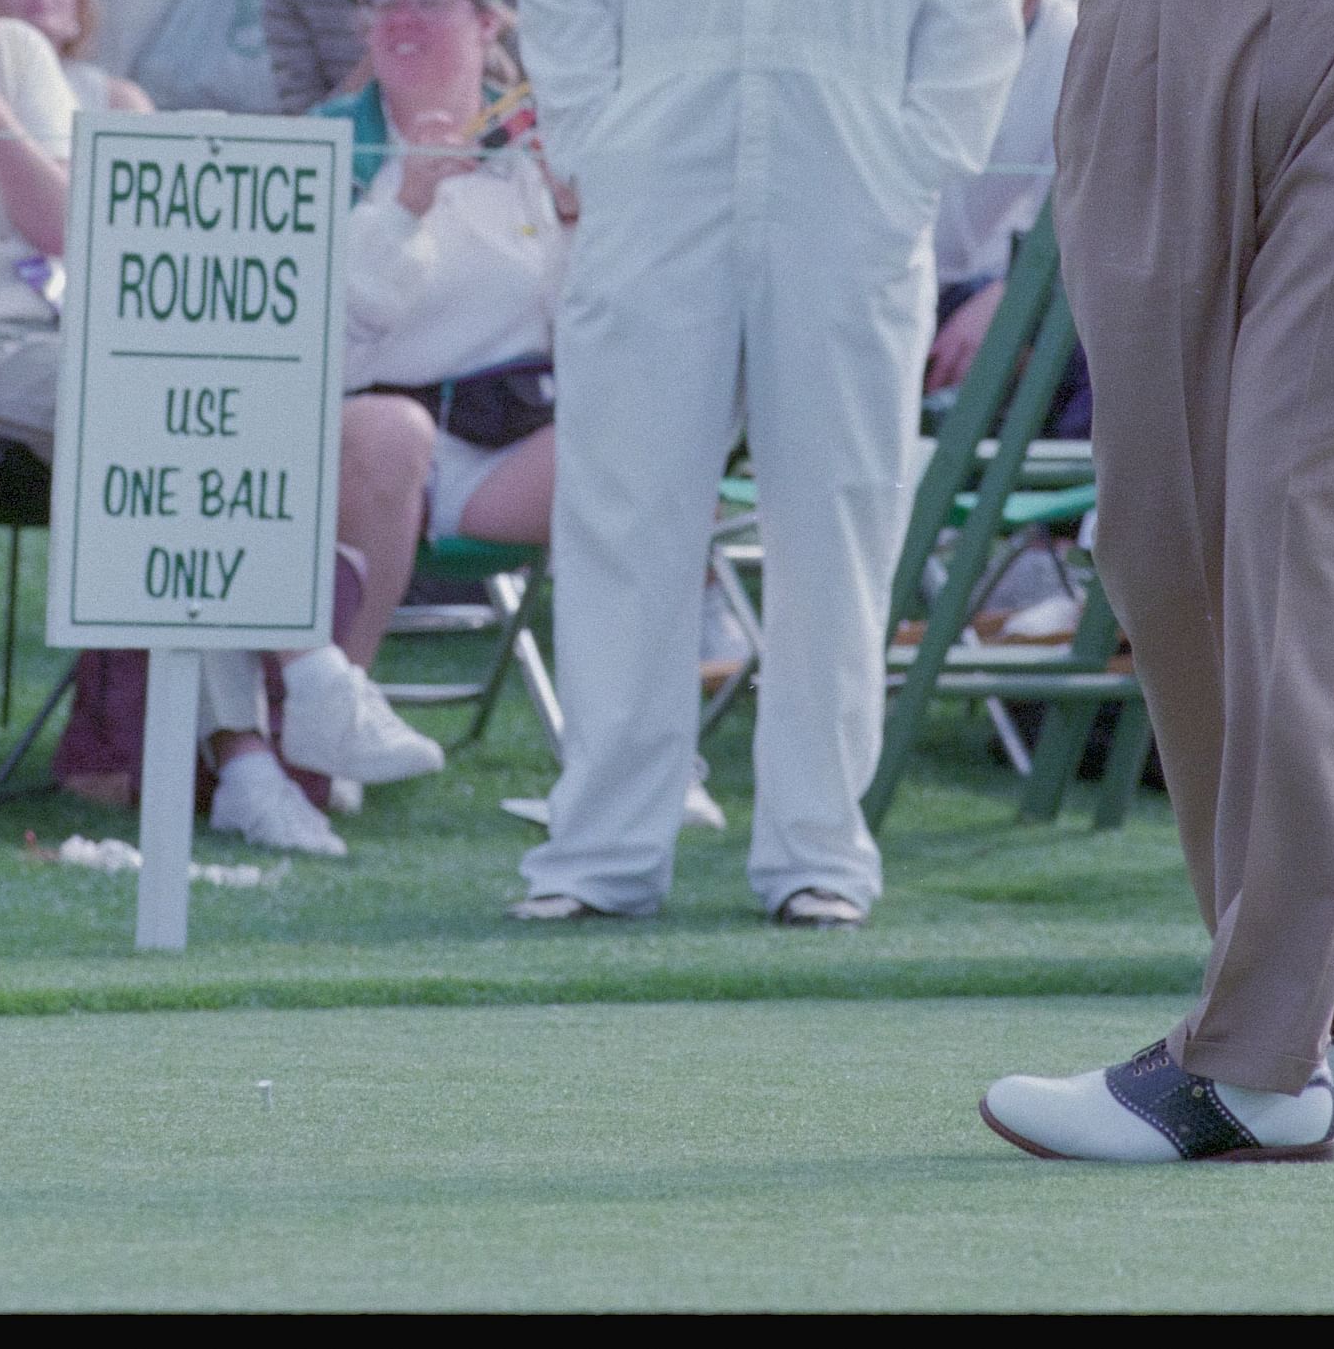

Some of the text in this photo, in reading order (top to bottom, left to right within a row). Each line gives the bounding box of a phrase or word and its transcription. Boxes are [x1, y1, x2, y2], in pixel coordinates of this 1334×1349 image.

[108, 160, 318, 233] PRACTICE
[117, 253, 300, 325] ROUNDS
[166, 388, 241, 437] USE
[103, 465, 294, 522] ONE BALL
[144, 547, 246, 601] ONLY
